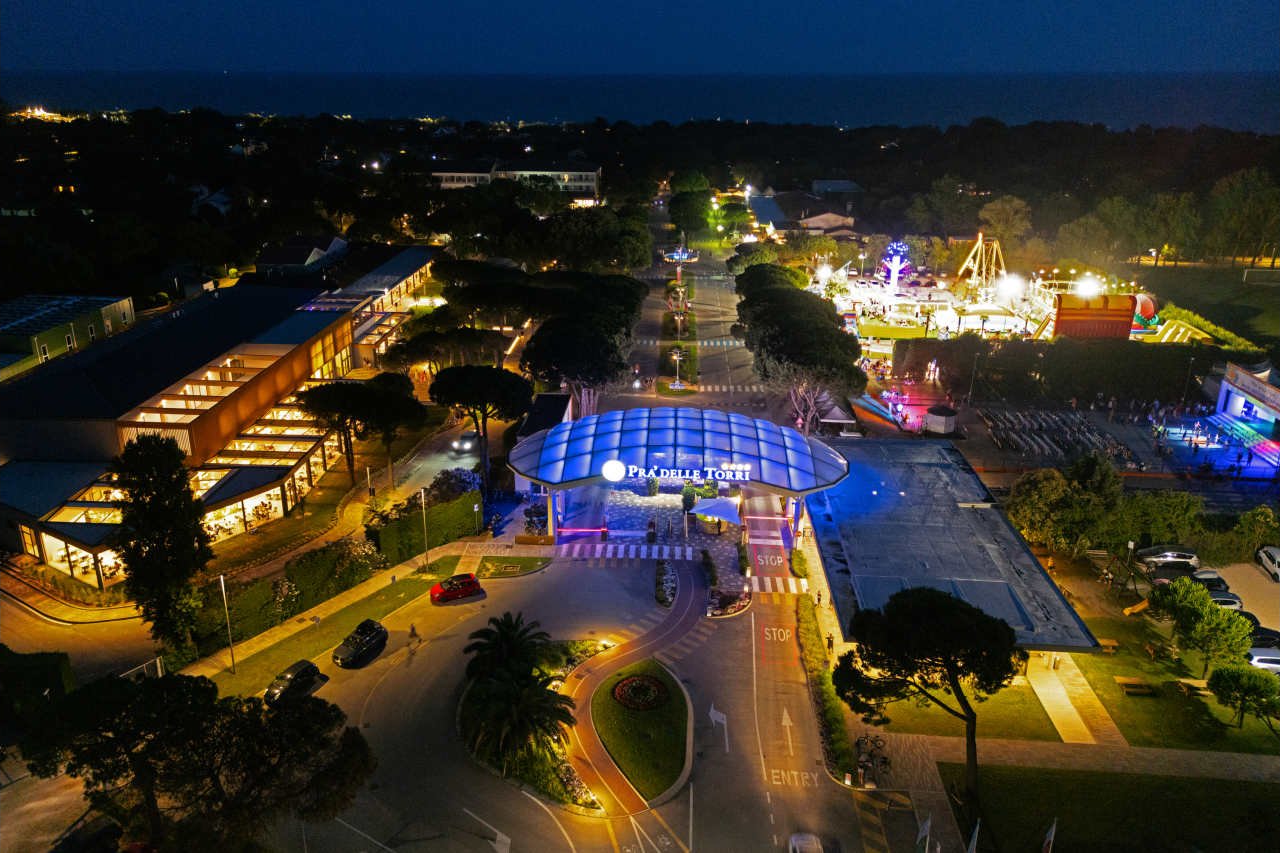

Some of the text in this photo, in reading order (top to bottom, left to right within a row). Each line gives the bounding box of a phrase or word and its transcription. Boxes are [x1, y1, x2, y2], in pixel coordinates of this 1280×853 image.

[660, 470, 701, 479] DELLE
[704, 467, 750, 480] TORRI
[757, 555, 783, 566] STOP
[764, 628, 792, 641] STOP
[771, 769, 818, 787] ENTRY
